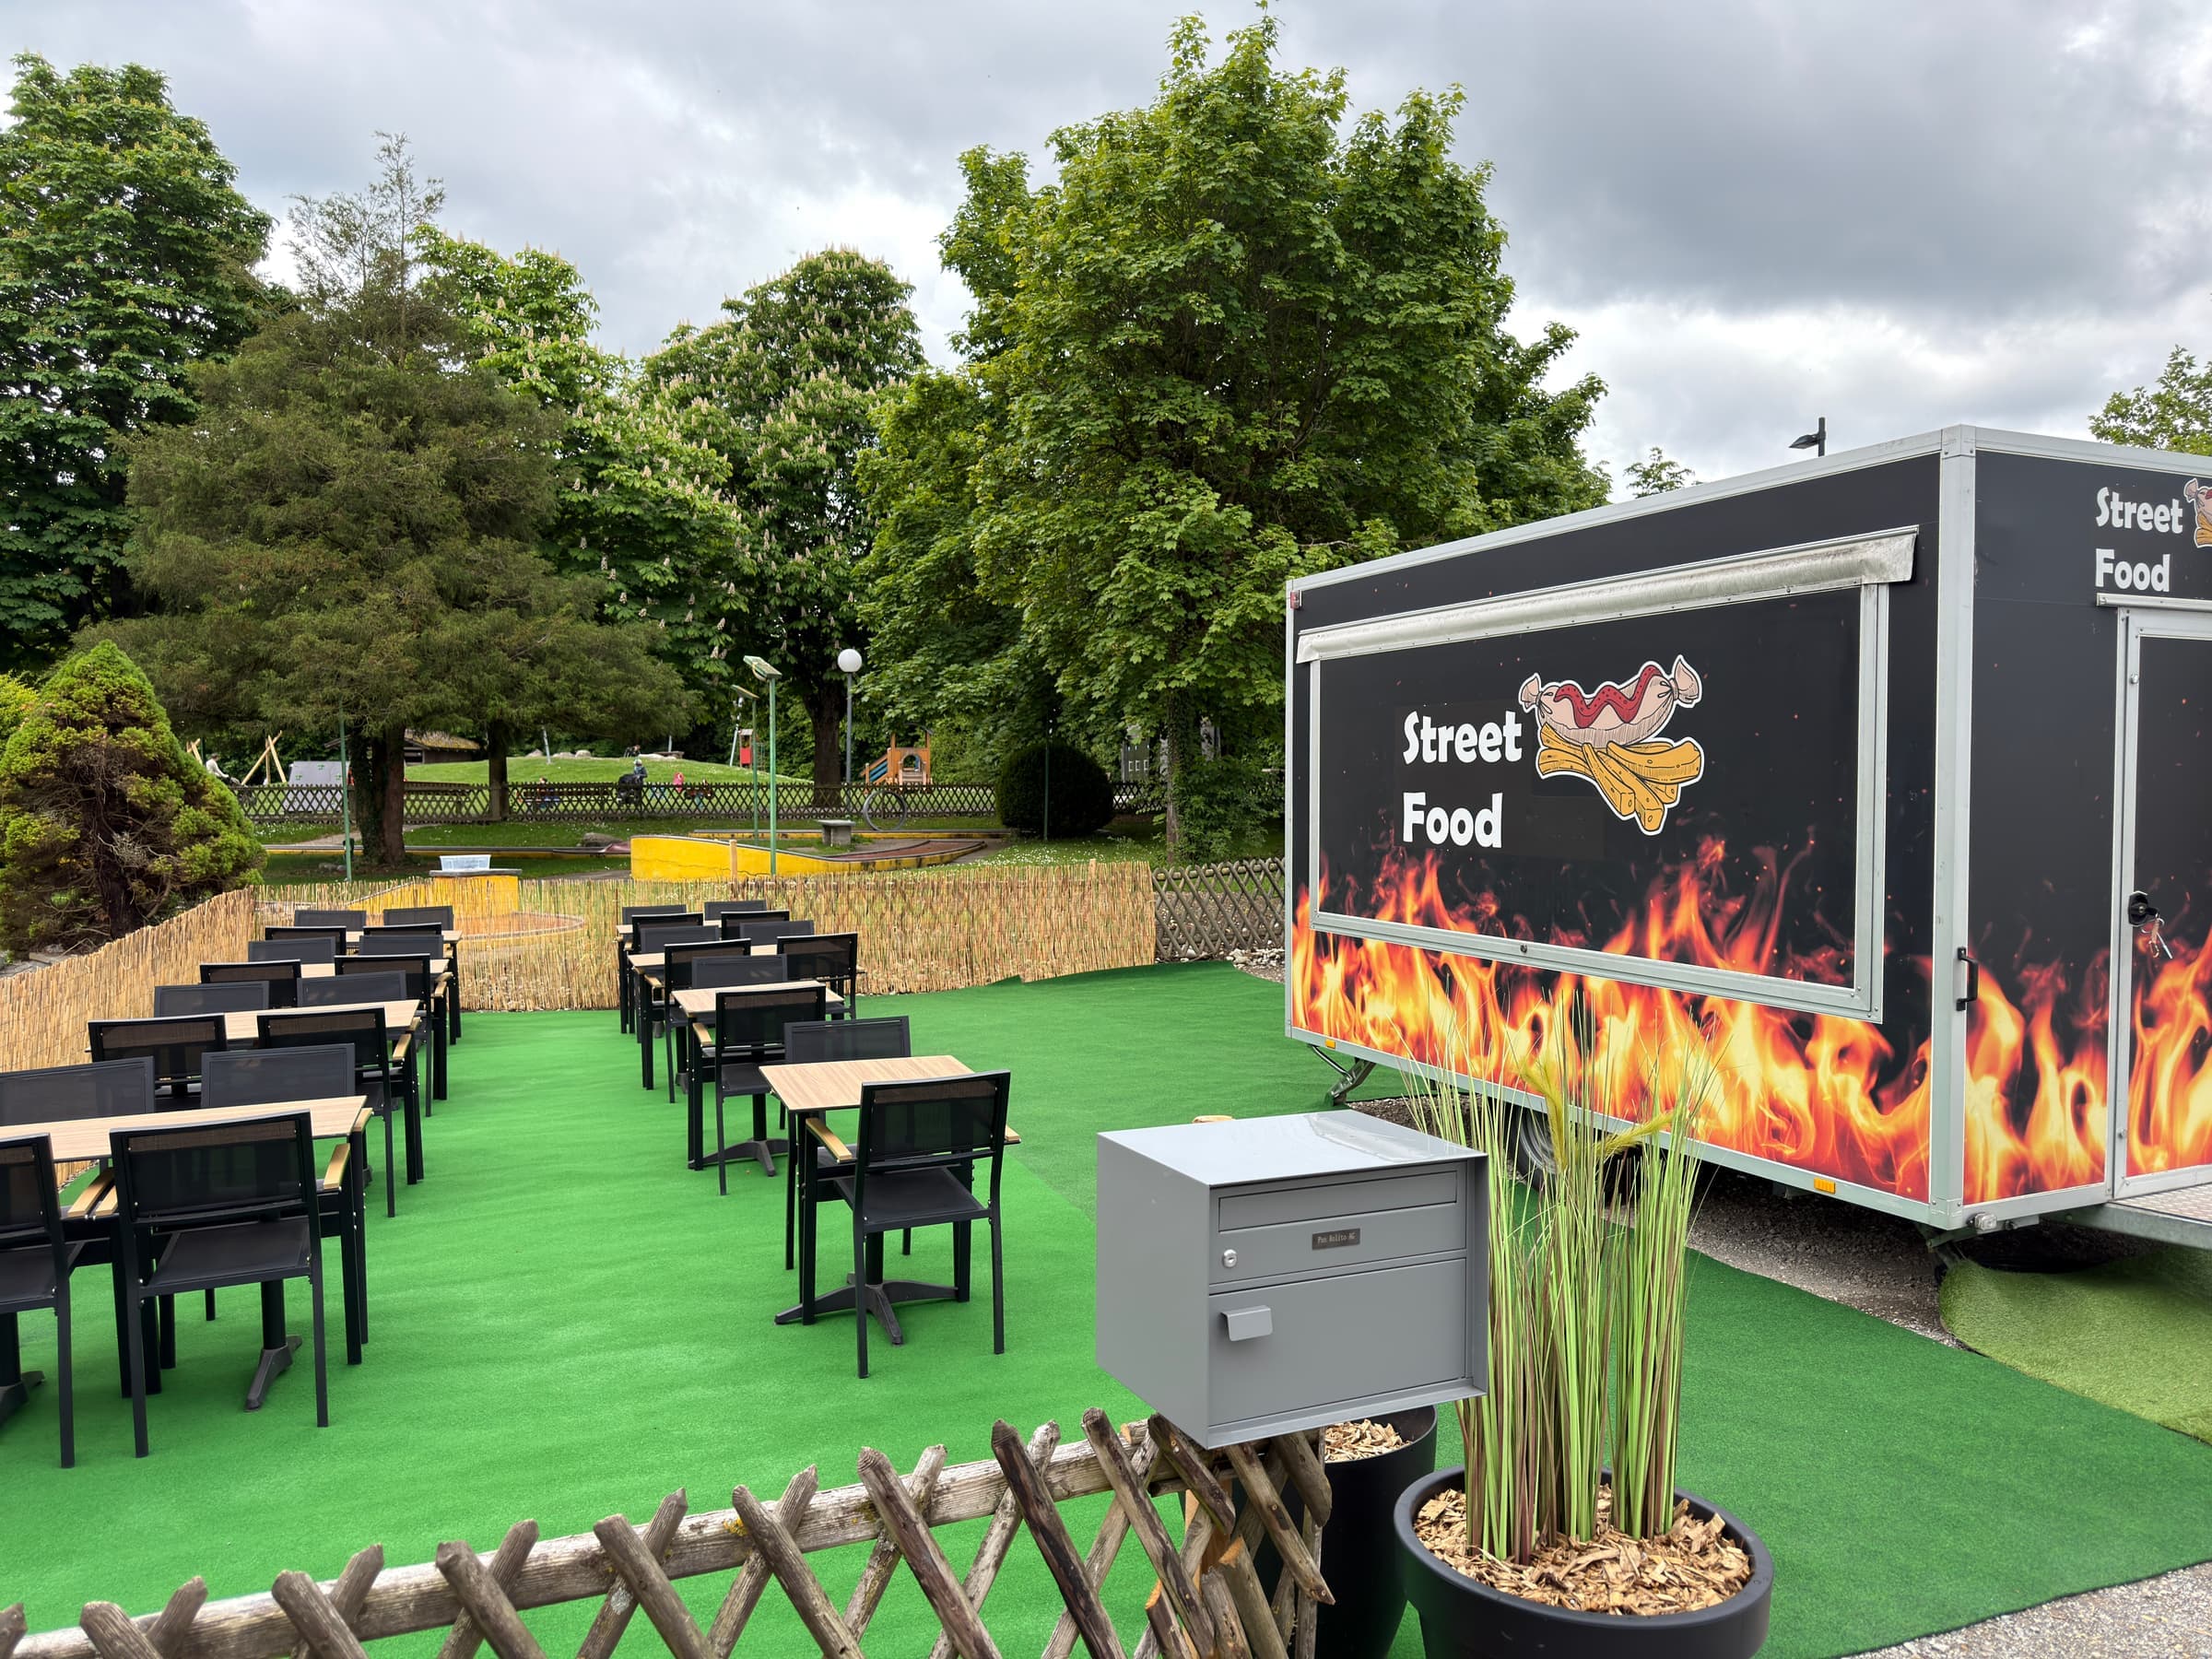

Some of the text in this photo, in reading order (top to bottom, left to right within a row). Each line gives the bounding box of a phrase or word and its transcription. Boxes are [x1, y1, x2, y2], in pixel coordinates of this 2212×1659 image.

[2095, 486, 2183, 535] Street
[2095, 547, 2171, 593] Food
[1403, 710, 1523, 765] Street
[1403, 792, 1503, 849] Food
